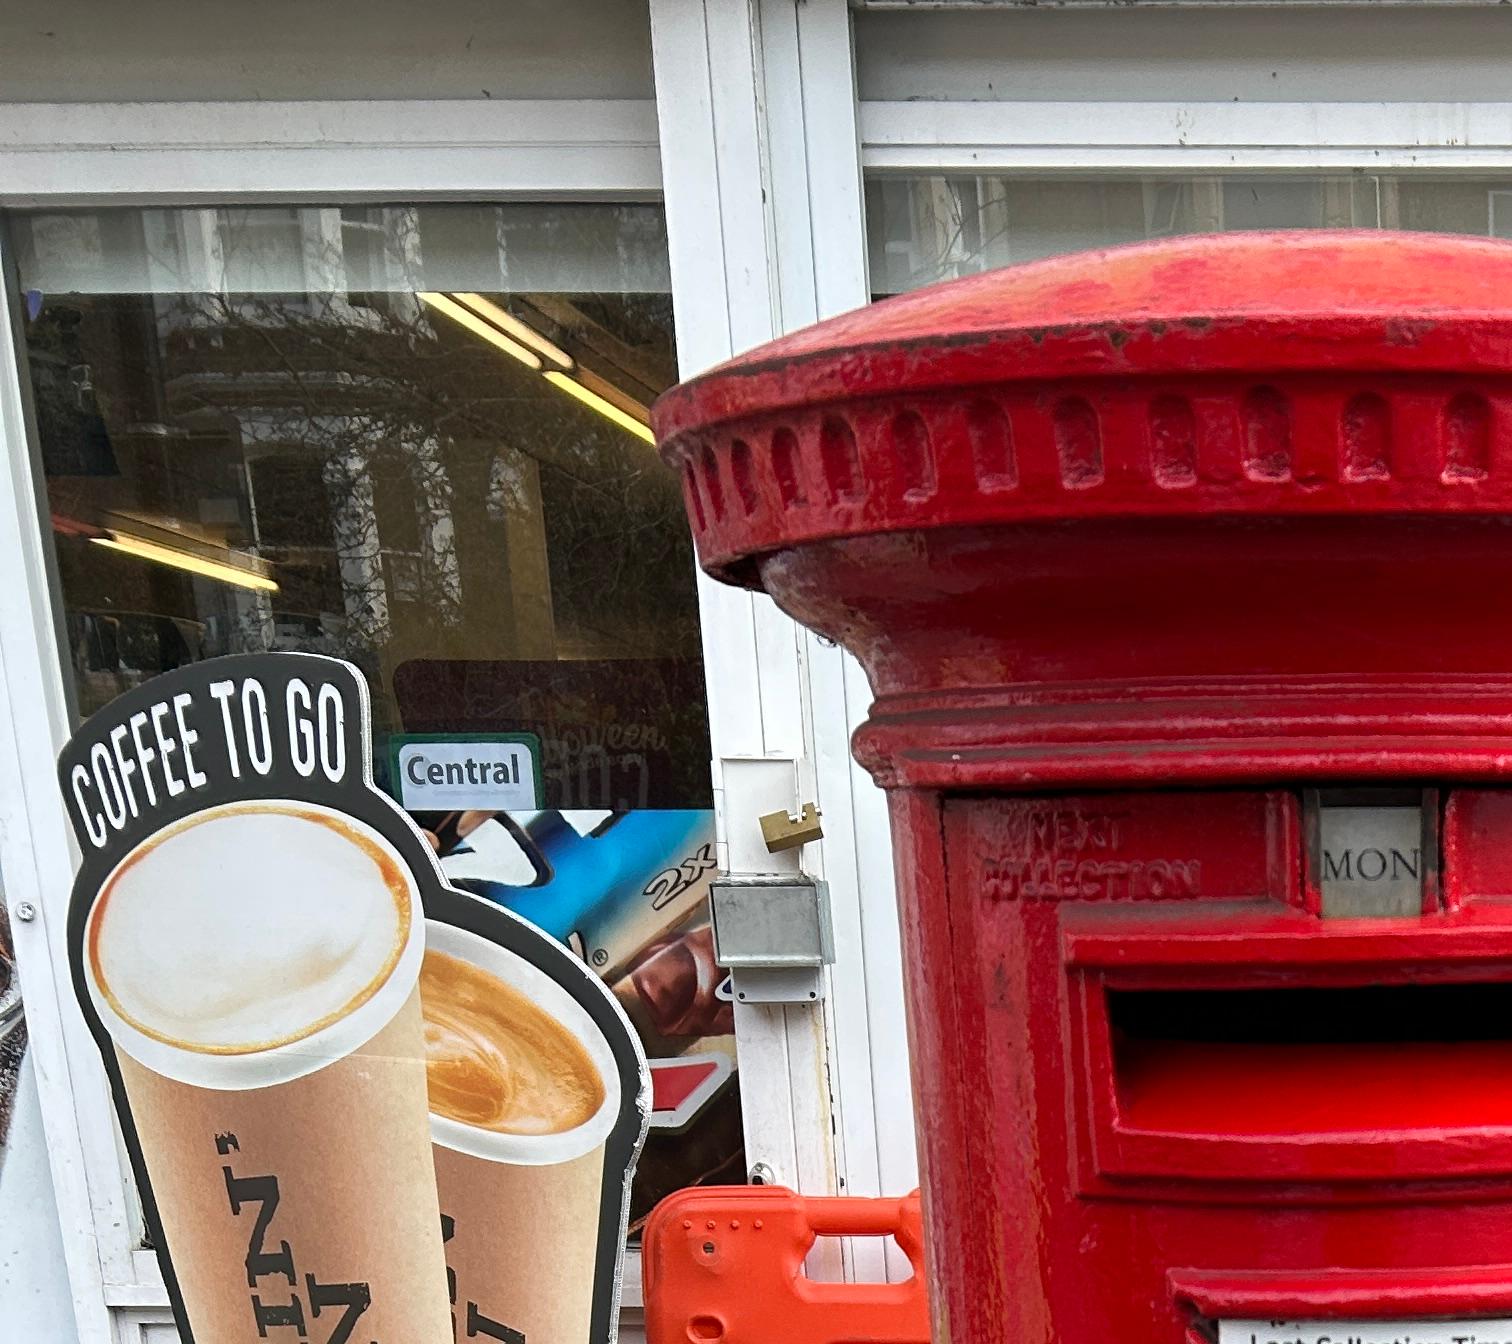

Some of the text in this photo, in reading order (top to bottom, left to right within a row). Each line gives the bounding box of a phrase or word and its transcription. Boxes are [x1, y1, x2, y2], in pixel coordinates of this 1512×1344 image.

[72, 678, 347, 849] COFFEE TO GO
[407, 753, 521, 787] Central
[1322, 847, 1421, 884] MON
